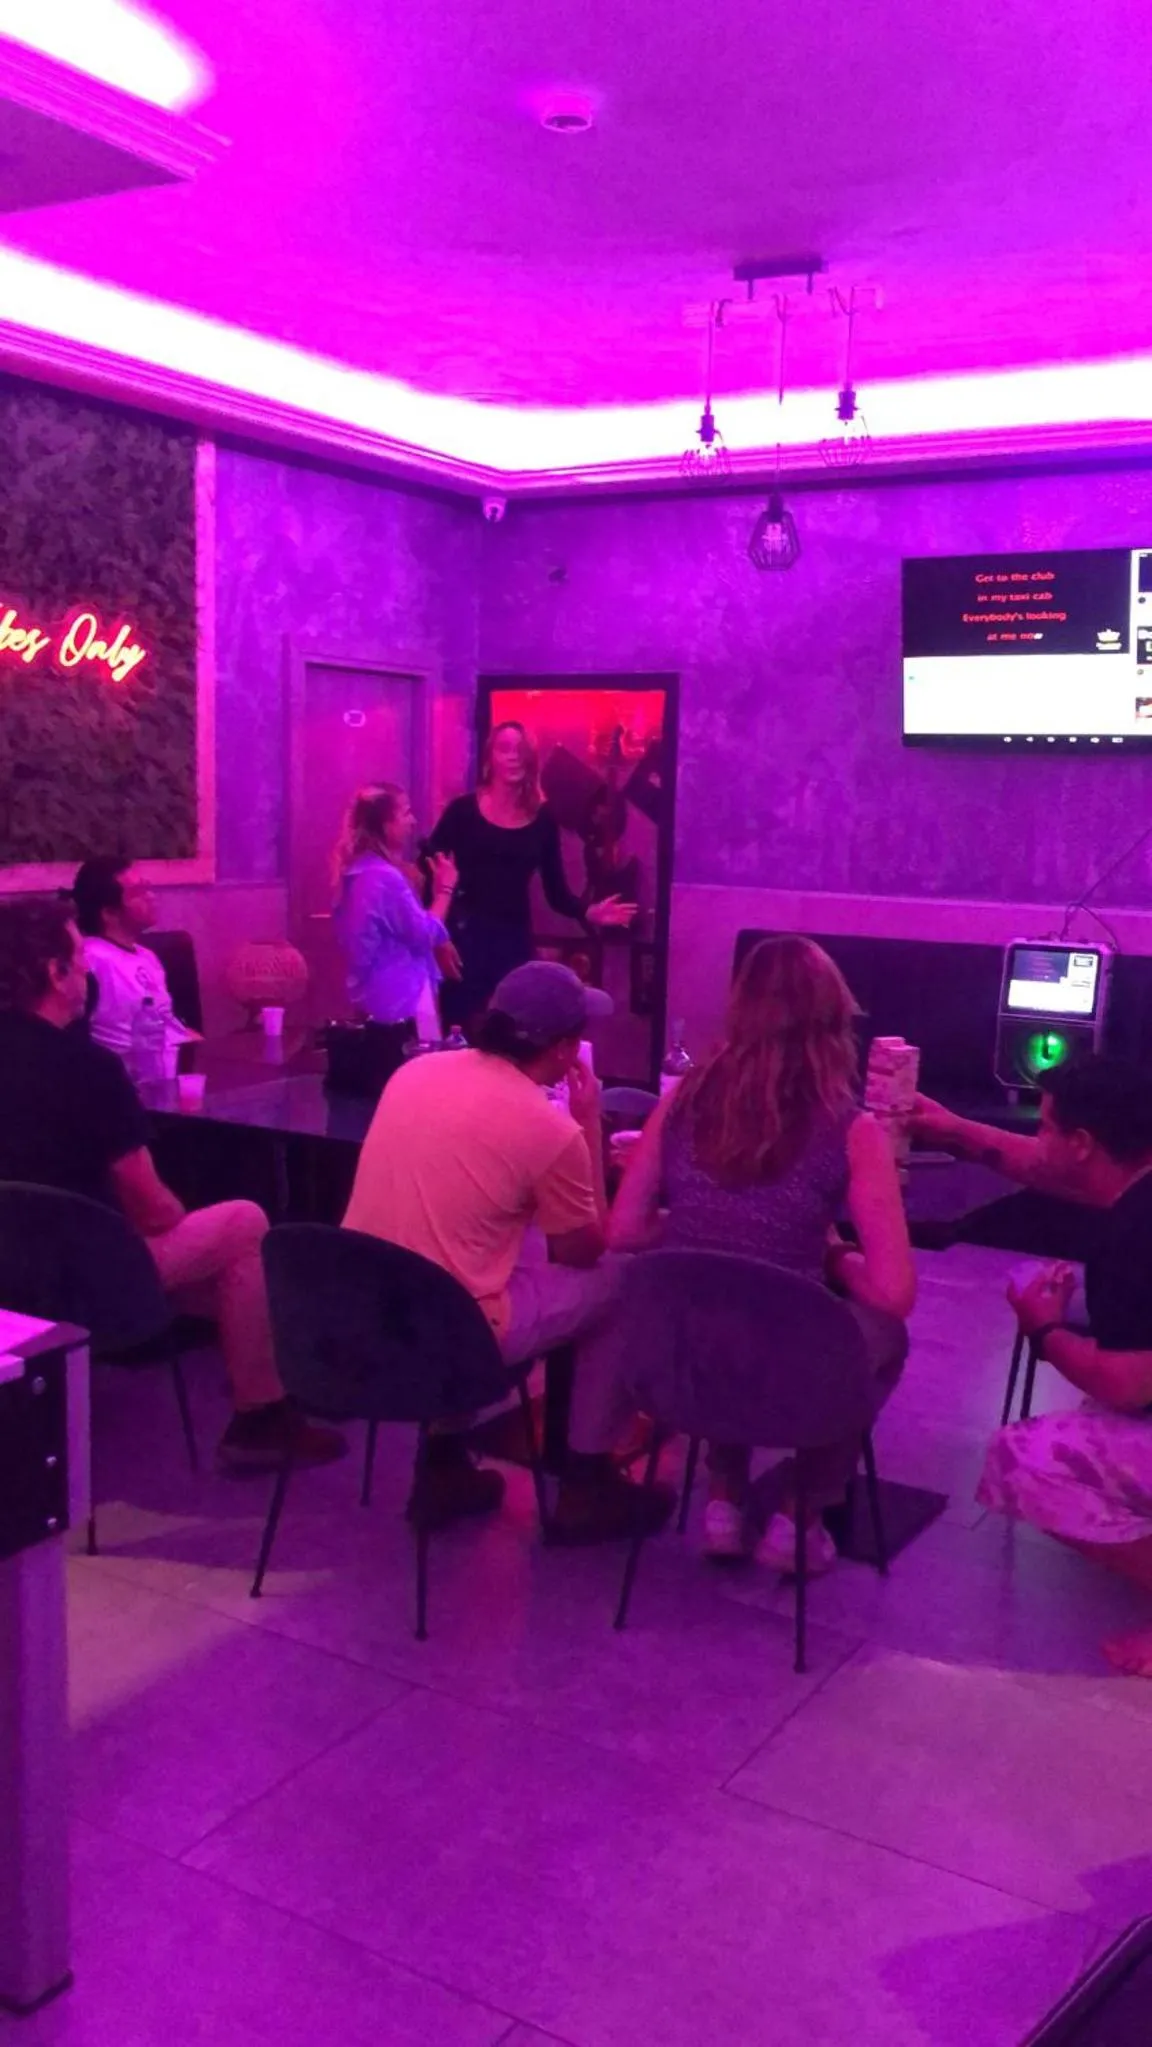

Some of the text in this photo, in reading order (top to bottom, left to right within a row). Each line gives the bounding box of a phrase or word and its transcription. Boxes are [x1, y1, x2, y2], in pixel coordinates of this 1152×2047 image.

[975, 571, 1055, 583] Get to the club
[977, 591, 1053, 603] in my taxi cab
[962, 611, 1067, 622] Everybody's looking
[1000, 633, 1017, 641] me
[0, 609, 147, 682] bes Only
